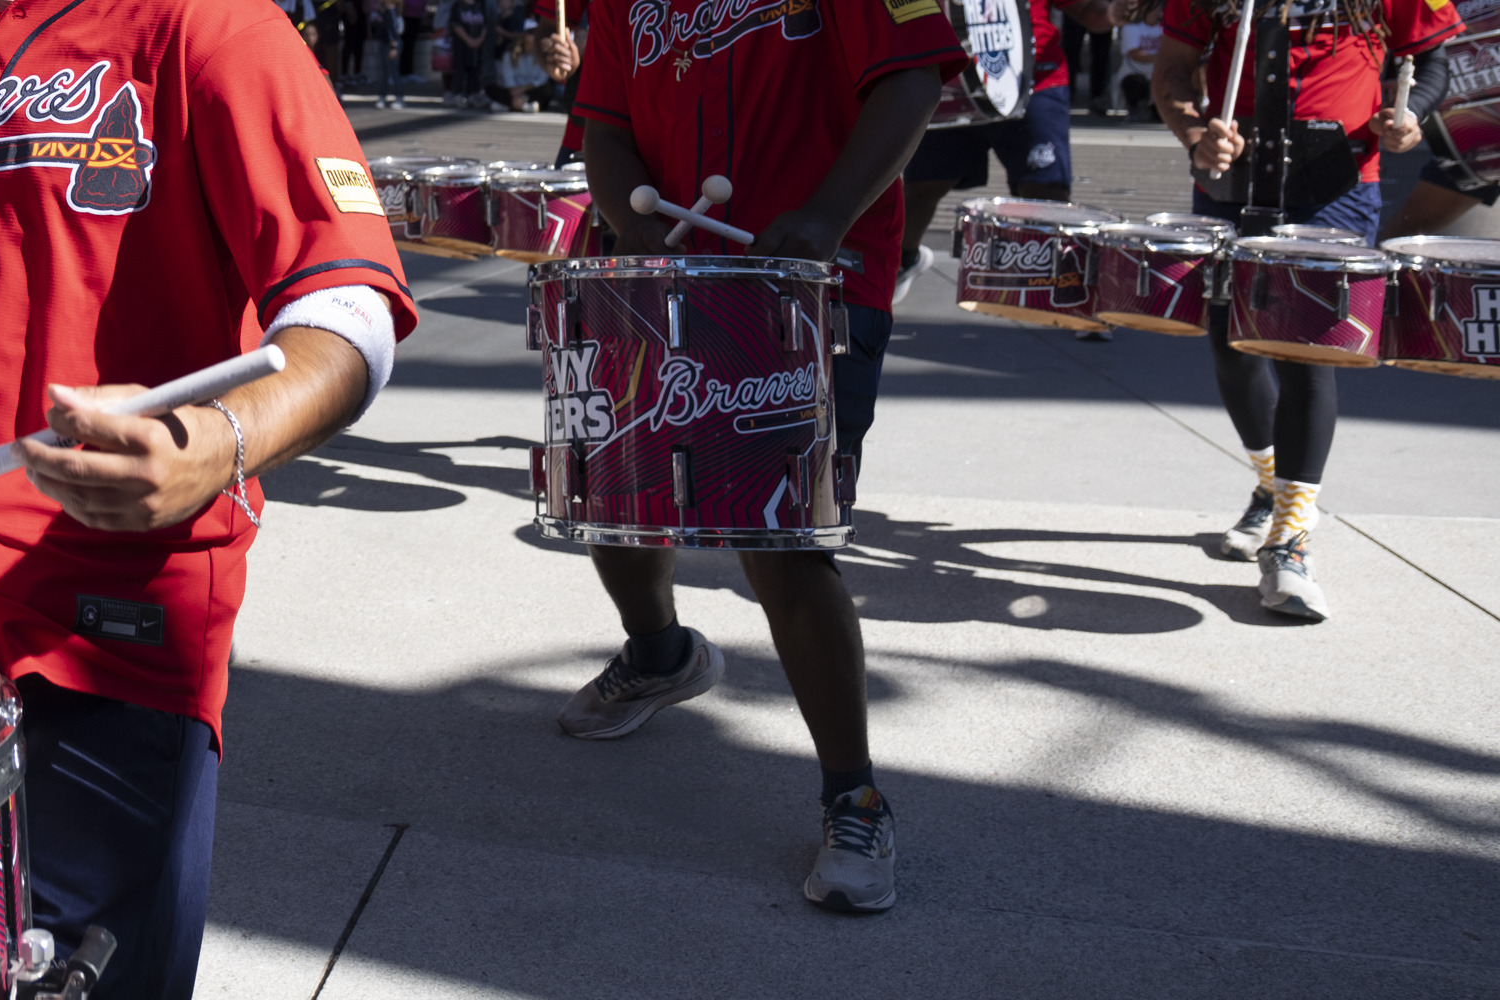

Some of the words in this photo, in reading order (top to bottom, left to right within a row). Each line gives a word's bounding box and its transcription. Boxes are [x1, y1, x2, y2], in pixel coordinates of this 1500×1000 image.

[967, 22, 1013, 55] HITTERS
[1449, 44, 1500, 78] HEAV
[332, 297, 355, 310] PLAY
[354, 306, 373, 328] BALL
[650, 356, 815, 433] Braves
[547, 395, 614, 442] ERS
